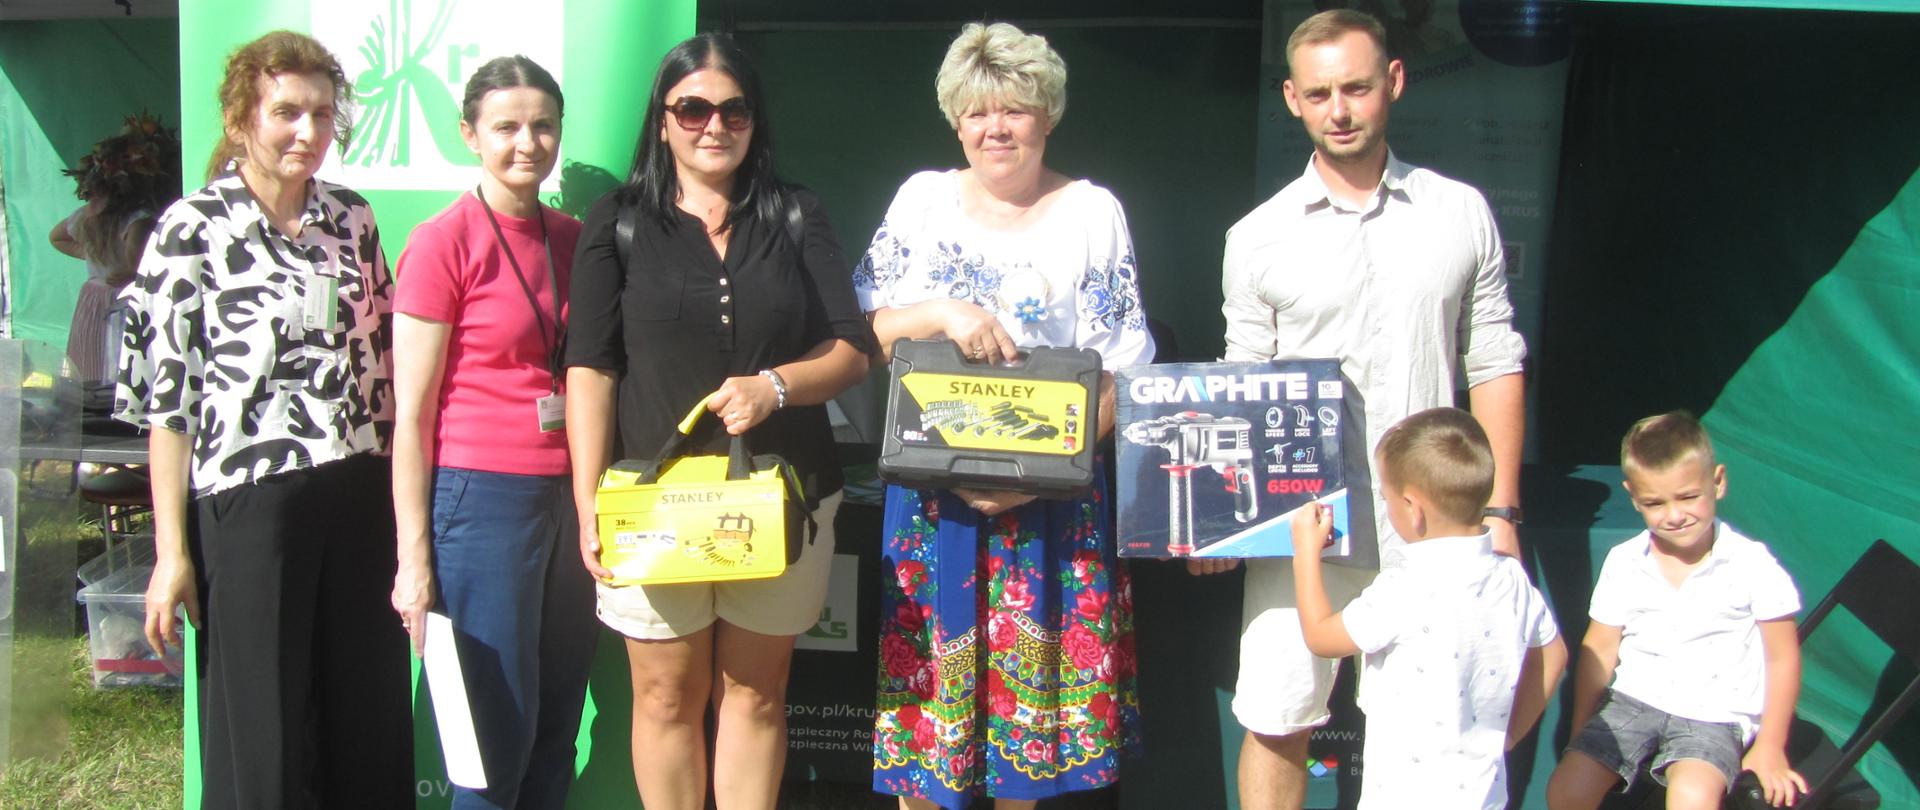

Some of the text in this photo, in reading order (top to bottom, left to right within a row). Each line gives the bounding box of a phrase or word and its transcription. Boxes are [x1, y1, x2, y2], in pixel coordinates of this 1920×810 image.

[1503, 206, 1540, 218] KRUS
[949, 381, 1035, 399] STANLEY
[1129, 372, 1308, 404] GRAPHITE
[1267, 479, 1324, 494] 650W
[661, 492, 724, 505] STANLEY
[786, 727, 849, 739] zpieczny
[786, 741, 848, 750] zpieczna
